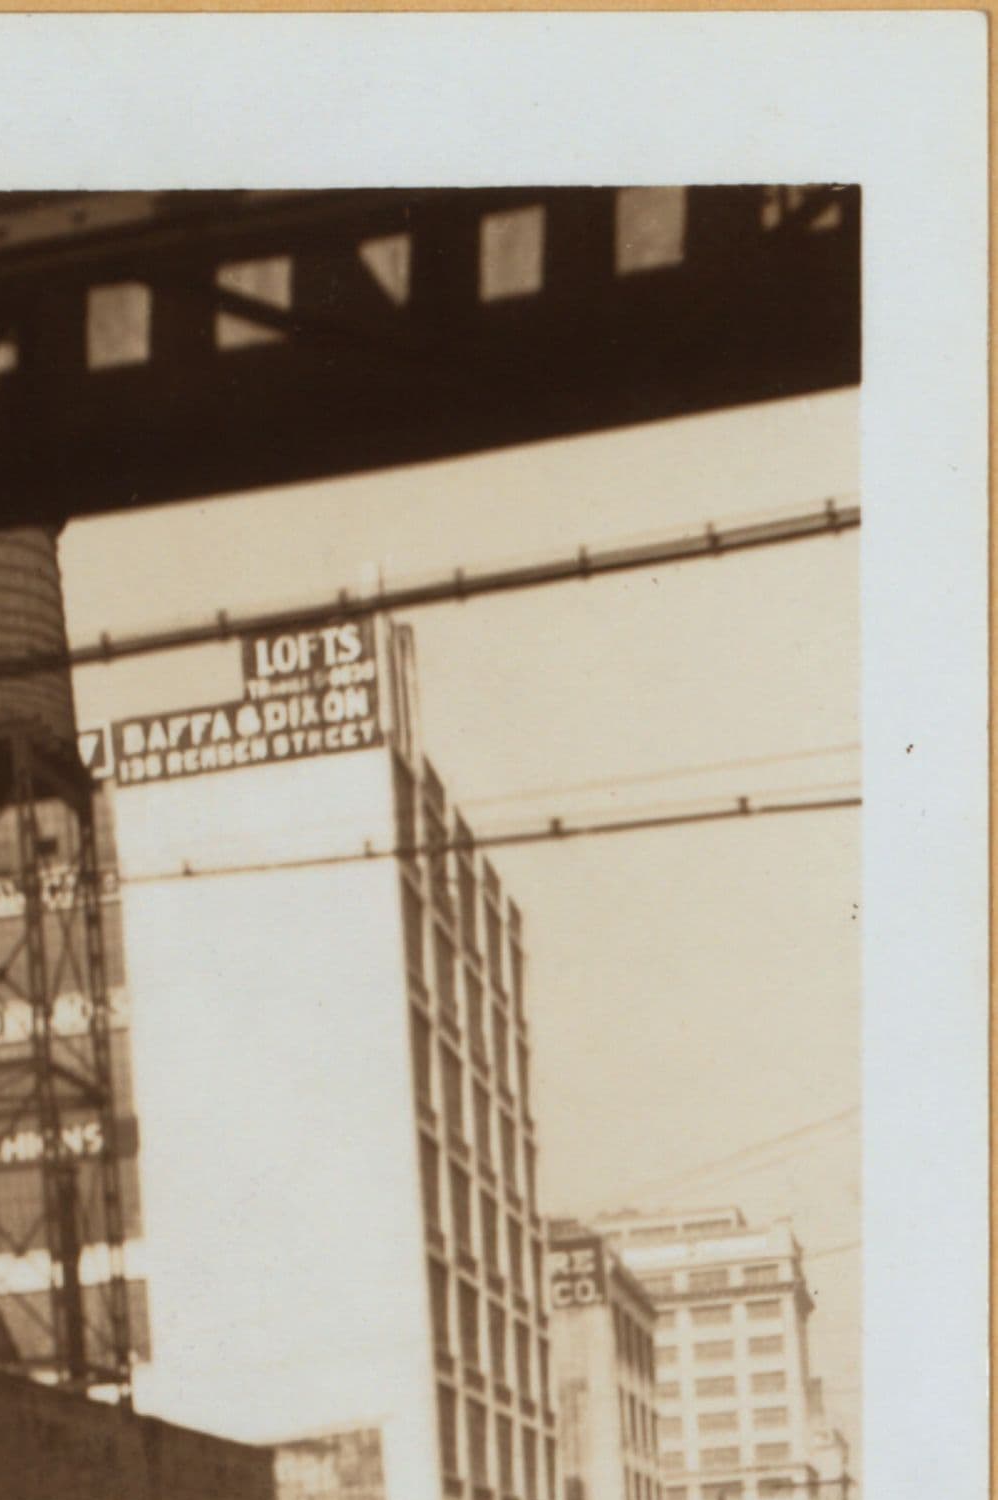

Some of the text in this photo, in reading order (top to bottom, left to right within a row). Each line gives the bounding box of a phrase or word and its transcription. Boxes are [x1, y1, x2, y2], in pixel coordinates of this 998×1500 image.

[255, 624, 362, 678] LOFTS
[262, 686, 369, 735] DIXON
[166, 737, 268, 776] REMSEN
[272, 718, 376, 758] STREET
